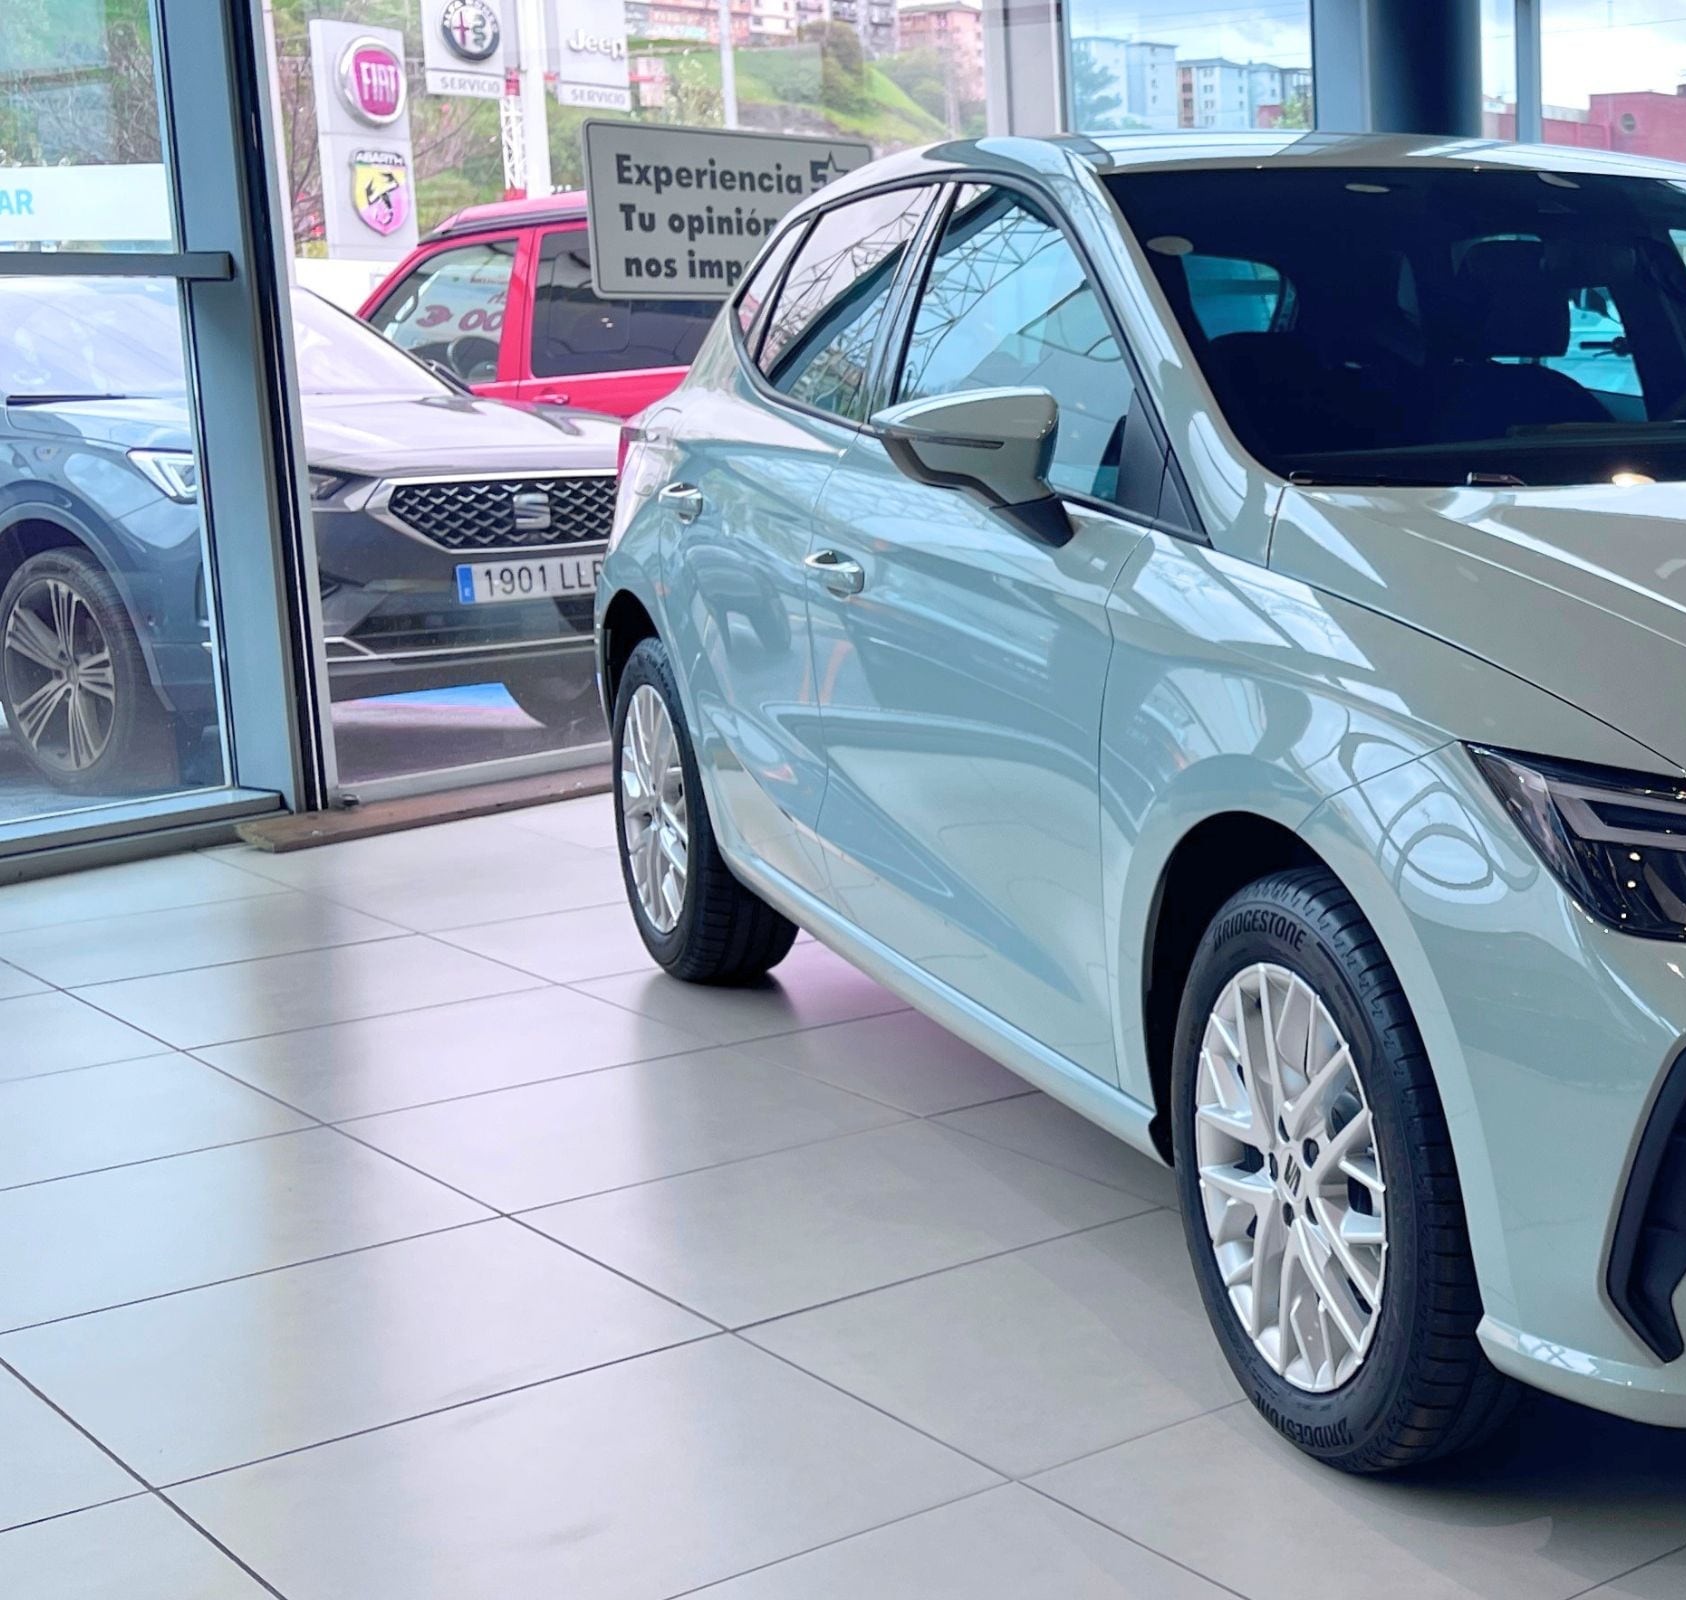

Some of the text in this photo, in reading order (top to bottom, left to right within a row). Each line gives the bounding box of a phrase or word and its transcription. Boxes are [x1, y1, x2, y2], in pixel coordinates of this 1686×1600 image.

[568, 29, 626, 61] Jeep
[359, 62, 399, 101] FIAT
[440, 76, 500, 93] SERVICIO
[571, 88, 626, 105] SERVICIO
[615, 153, 803, 194] Experiencia
[619, 203, 656, 233] Tu
[624, 250, 752, 287] nos imp
[484, 564, 547, 597] 1901
[1213, 908, 1307, 953] BRIDGESTONE
